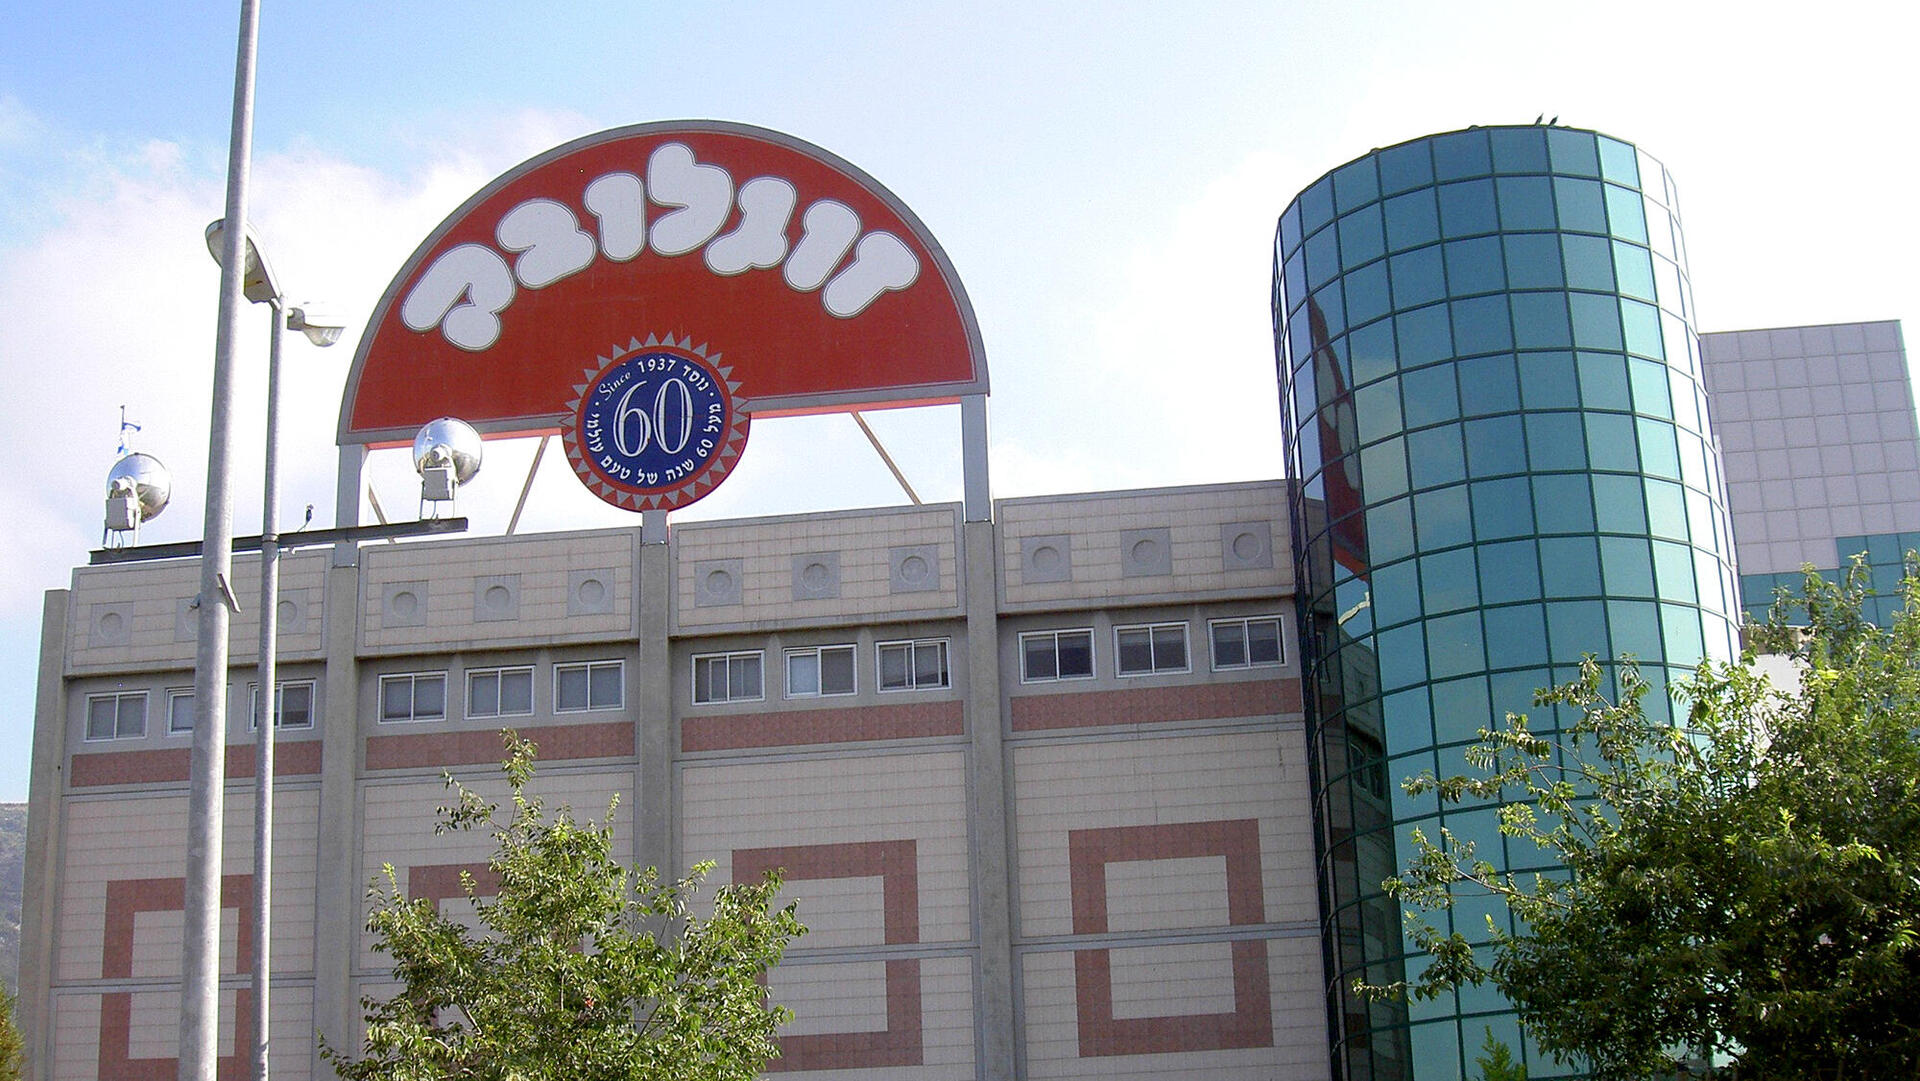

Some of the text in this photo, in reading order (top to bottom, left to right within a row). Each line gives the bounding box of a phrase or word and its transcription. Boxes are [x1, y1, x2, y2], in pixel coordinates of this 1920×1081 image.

[401, 142, 920, 351] זוגלובק
[599, 358, 676, 401] Since 1937
[613, 378, 694, 457] 60
[682, 365, 710, 392] נוסד
[586, 403, 722, 485] מעל 60 שנה של טעם עולמי
